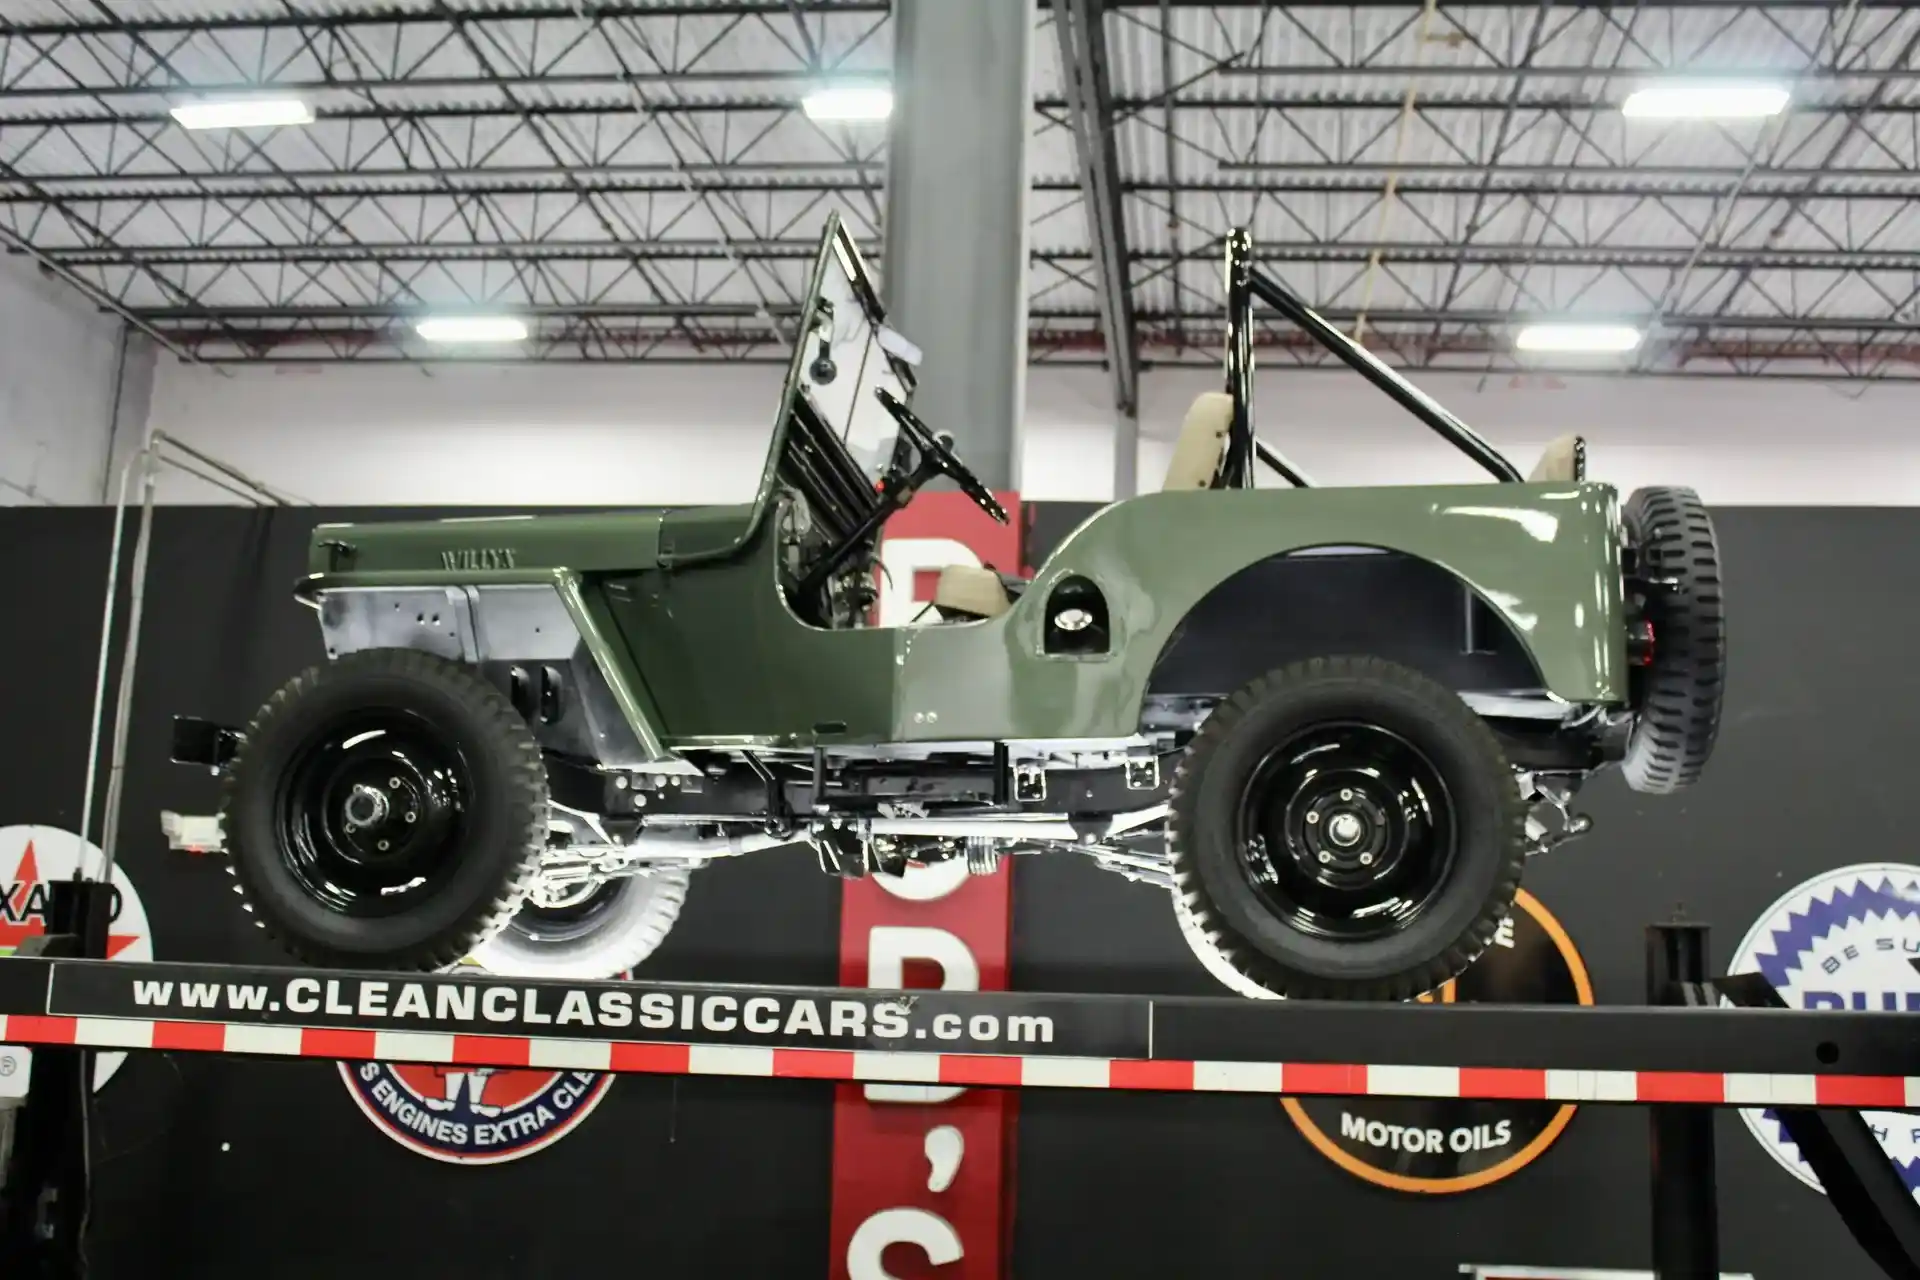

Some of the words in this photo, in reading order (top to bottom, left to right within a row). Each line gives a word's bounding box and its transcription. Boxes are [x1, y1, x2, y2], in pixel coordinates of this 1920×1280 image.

[1820, 944, 1859, 975] BE
[133, 976, 1054, 1043] www.CLEANCLASSICCARS.com
[371, 1079, 468, 1145] ENGINES
[474, 1107, 556, 1145] EXTRA
[1341, 1111, 1444, 1153] MOTOR
[1450, 1119, 1512, 1152] OILS
